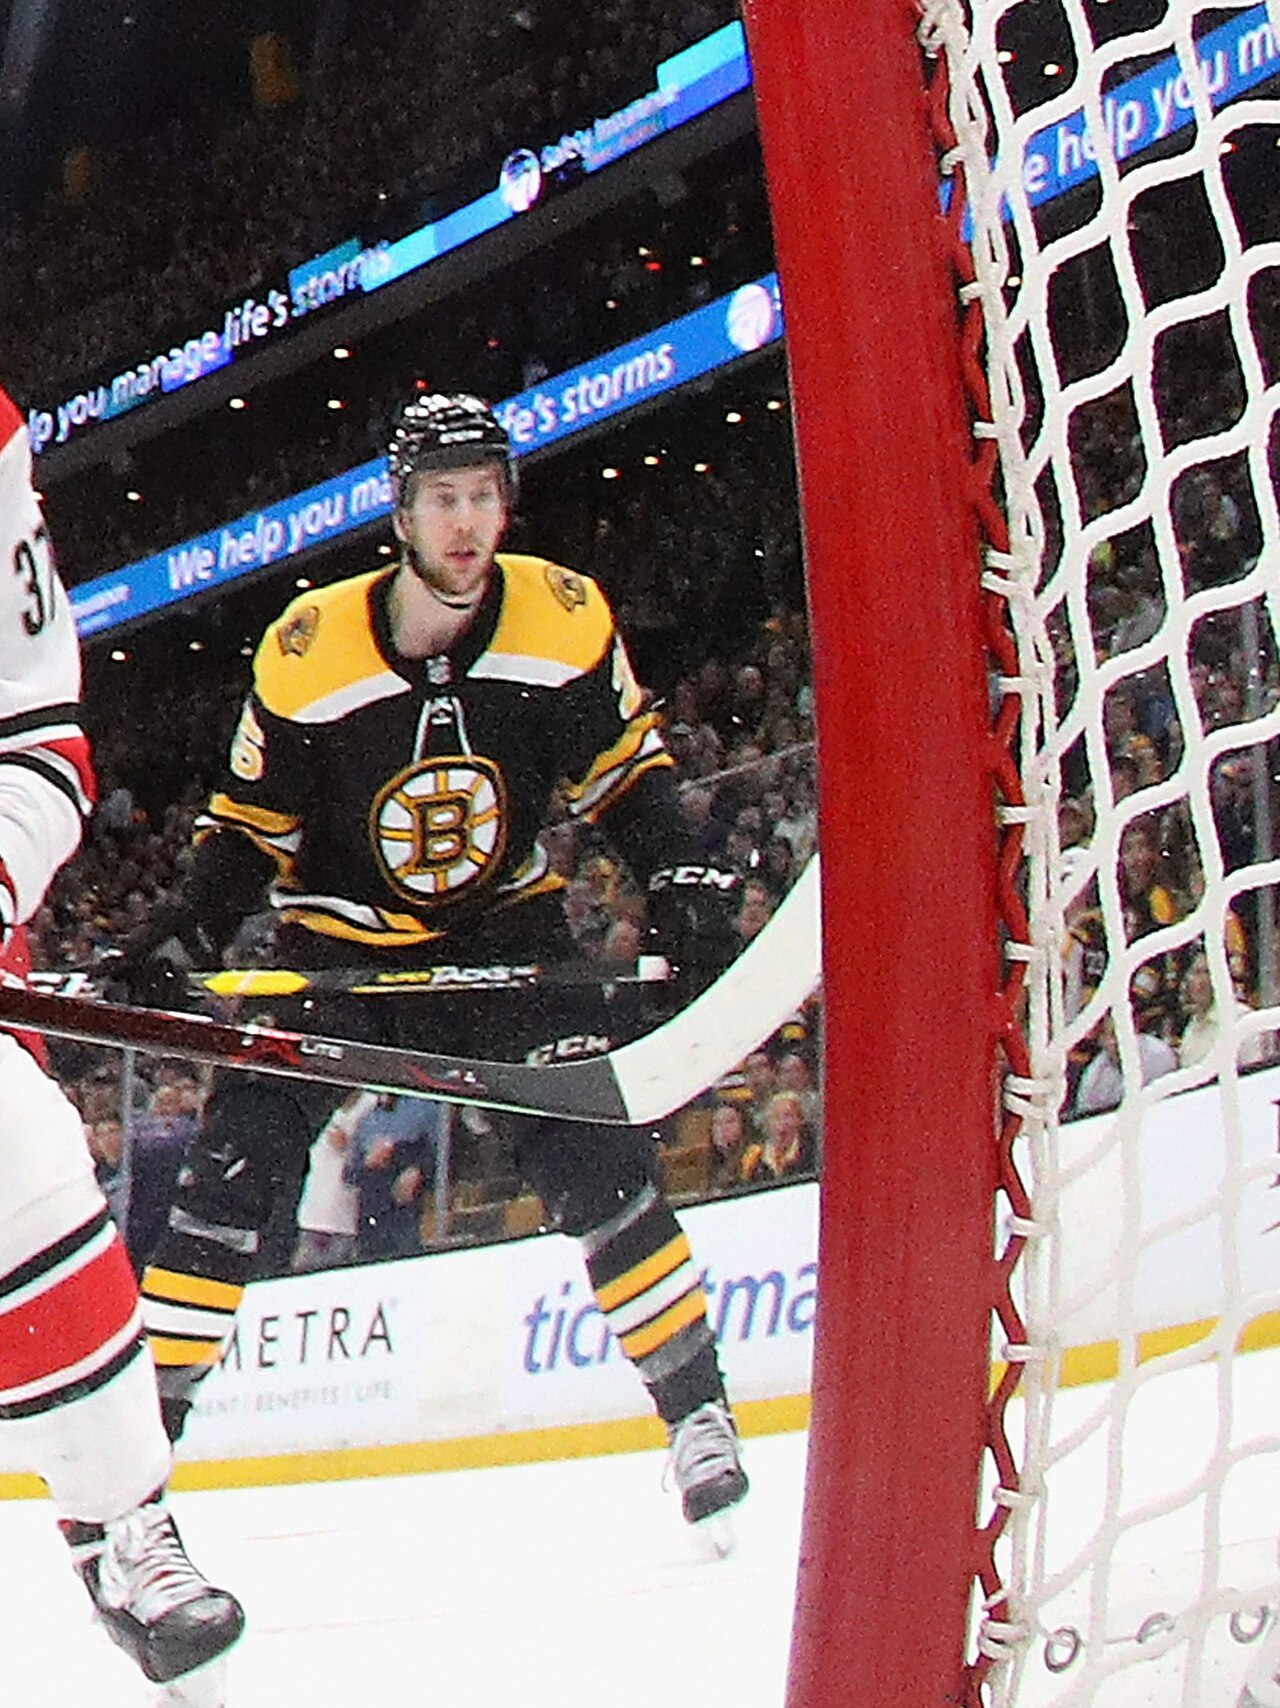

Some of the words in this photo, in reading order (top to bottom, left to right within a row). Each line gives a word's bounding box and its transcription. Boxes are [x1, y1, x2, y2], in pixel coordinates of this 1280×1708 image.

[56, 386, 107, 443] you
[111, 330, 220, 403] manage
[224, 289, 289, 350] life's
[291, 240, 391, 318] storms
[495, 394, 558, 442] fe's
[561, 343, 677, 423] storms
[167, 546, 217, 591] We
[219, 514, 284, 565] help
[287, 493, 346, 554] you
